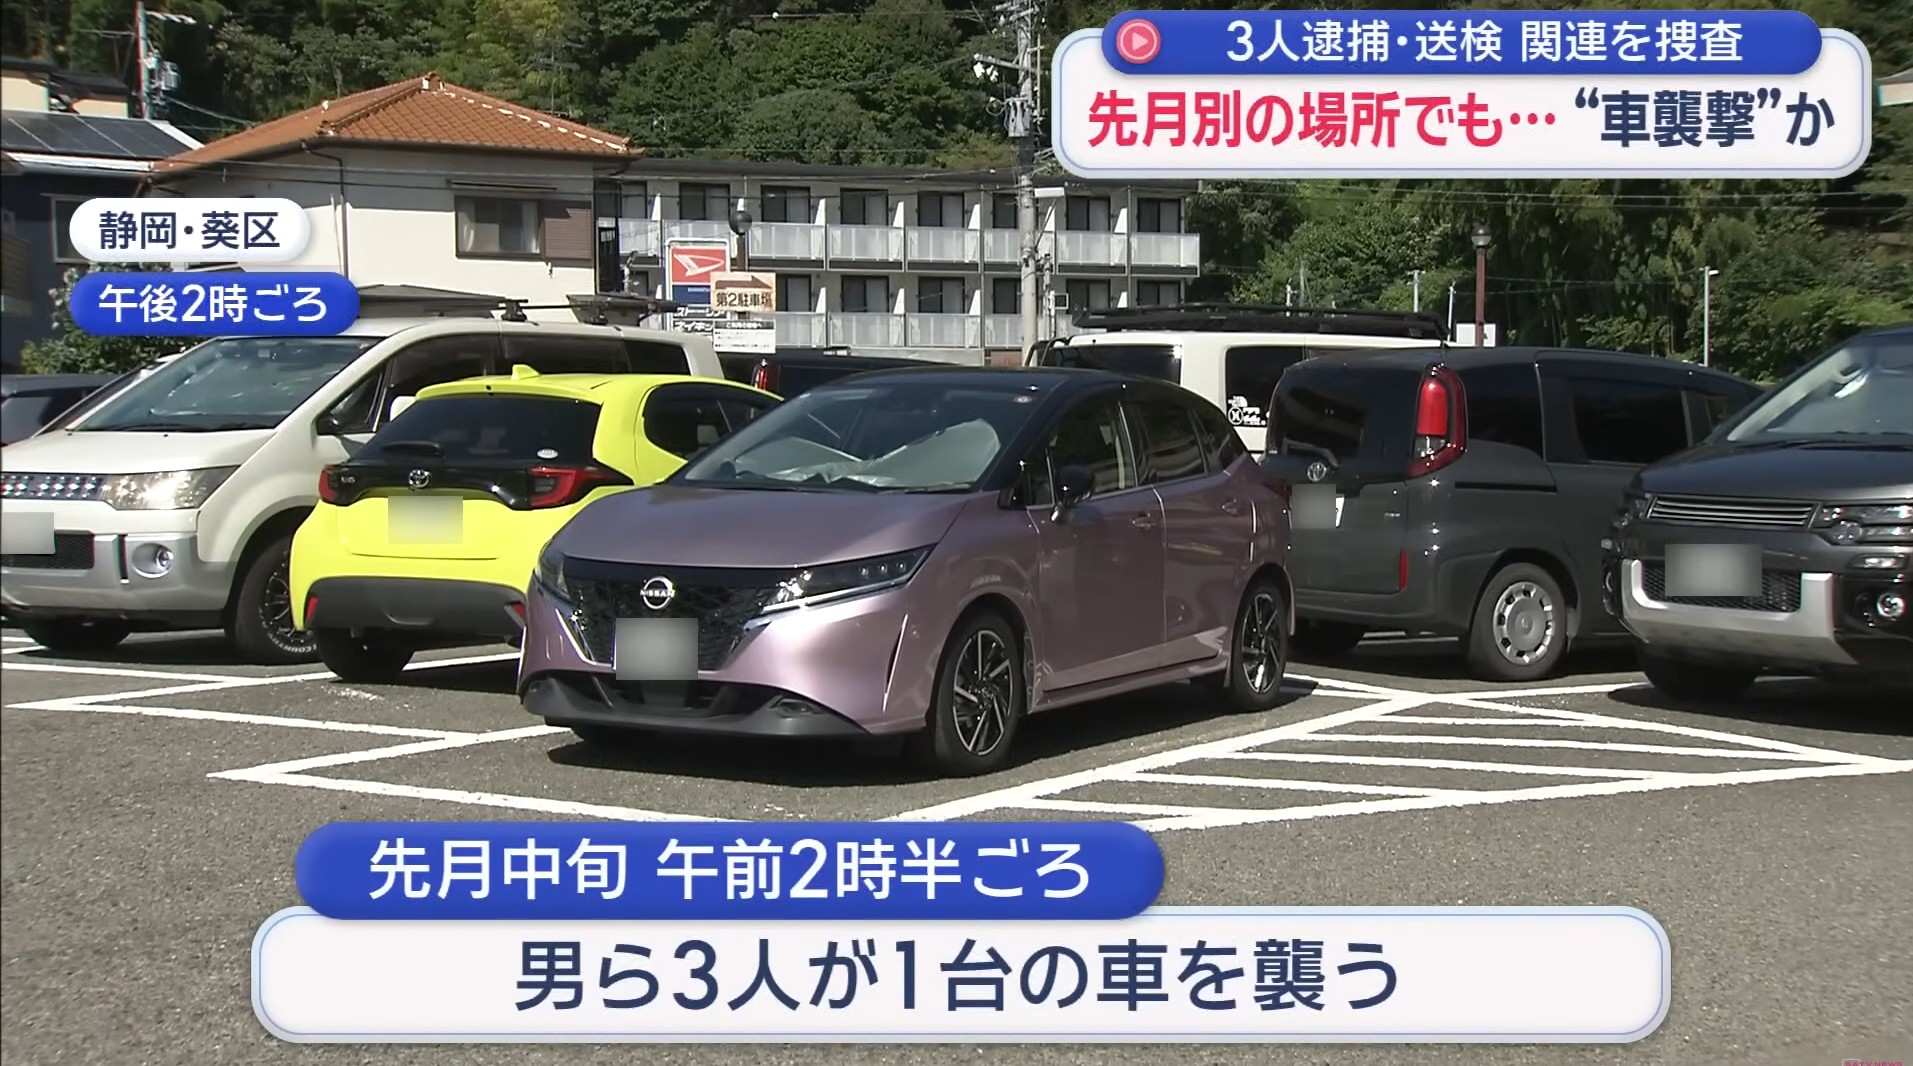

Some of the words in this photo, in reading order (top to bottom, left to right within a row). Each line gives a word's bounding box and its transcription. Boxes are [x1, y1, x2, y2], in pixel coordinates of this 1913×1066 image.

[716, 291, 773, 307] 第2駐車場
[640, 589, 676, 598] NISSAN
